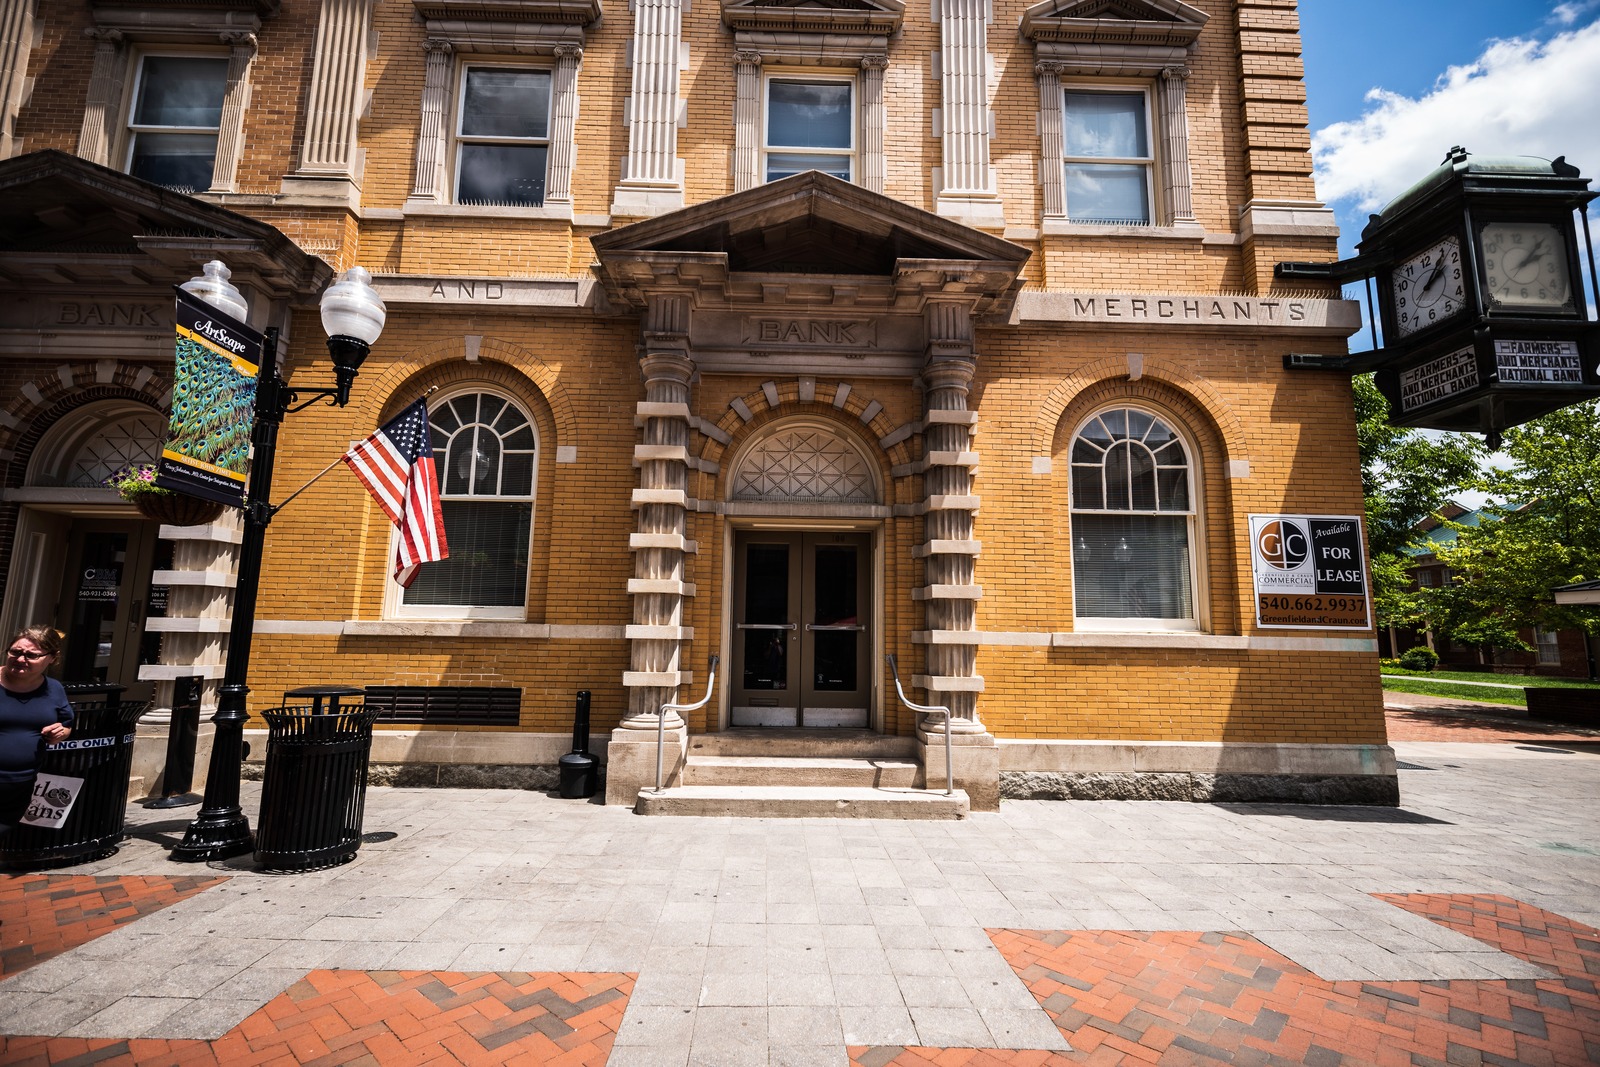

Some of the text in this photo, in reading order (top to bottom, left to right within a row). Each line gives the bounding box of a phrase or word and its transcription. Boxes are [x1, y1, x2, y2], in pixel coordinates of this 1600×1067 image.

[1494, 233, 1503, 243] 11
[1511, 233, 1522, 244] 12
[1484, 243, 1496, 254] 10
[1545, 245, 1553, 255] 2
[1420, 256, 1431, 268] 12
[1452, 252, 1458, 263] 2
[1487, 260, 1494, 270] 9
[1547, 263, 1555, 273] 3
[1405, 265, 1413, 277] 11
[1454, 268, 1460, 279] 3
[1398, 280, 1408, 292] 10
[1489, 277, 1497, 287] 8
[1549, 279, 1556, 288] 4
[429, 281, 503, 300] AND
[1456, 286, 1462, 296] 4
[1503, 288, 1509, 298] 7
[1521, 288, 1528, 298] 6
[1539, 289, 1546, 299] 5
[1400, 298, 1406, 307] 9
[1445, 301, 1452, 312] 5
[57, 302, 162, 326] BANK
[1073, 298, 1306, 321] MERCHANTS
[1429, 309, 1436, 319] 6
[1402, 313, 1407, 323] 8
[1414, 316, 1419, 327] 7
[194, 320, 246, 352] ArtScape
[760, 320, 857, 343] BANK
[1511, 342, 1560, 354] FARMERS
[1414, 353, 1458, 380] FARMERS
[1497, 356, 1579, 368] AND MERCHANTS
[1403, 361, 1476, 398] AND MERCHANTS
[1500, 369, 1581, 381] NATIONAL BANK
[1404, 373, 1478, 410] NATIONAL BANK
[1315, 523, 1350, 539] Available
[1322, 547, 1351, 559] FOR
[1317, 569, 1361, 582] LEASE
[1260, 597, 1364, 611] 540.662.9937
[82, 737, 114, 747] ONLY
[28, 805, 64, 820] ans
